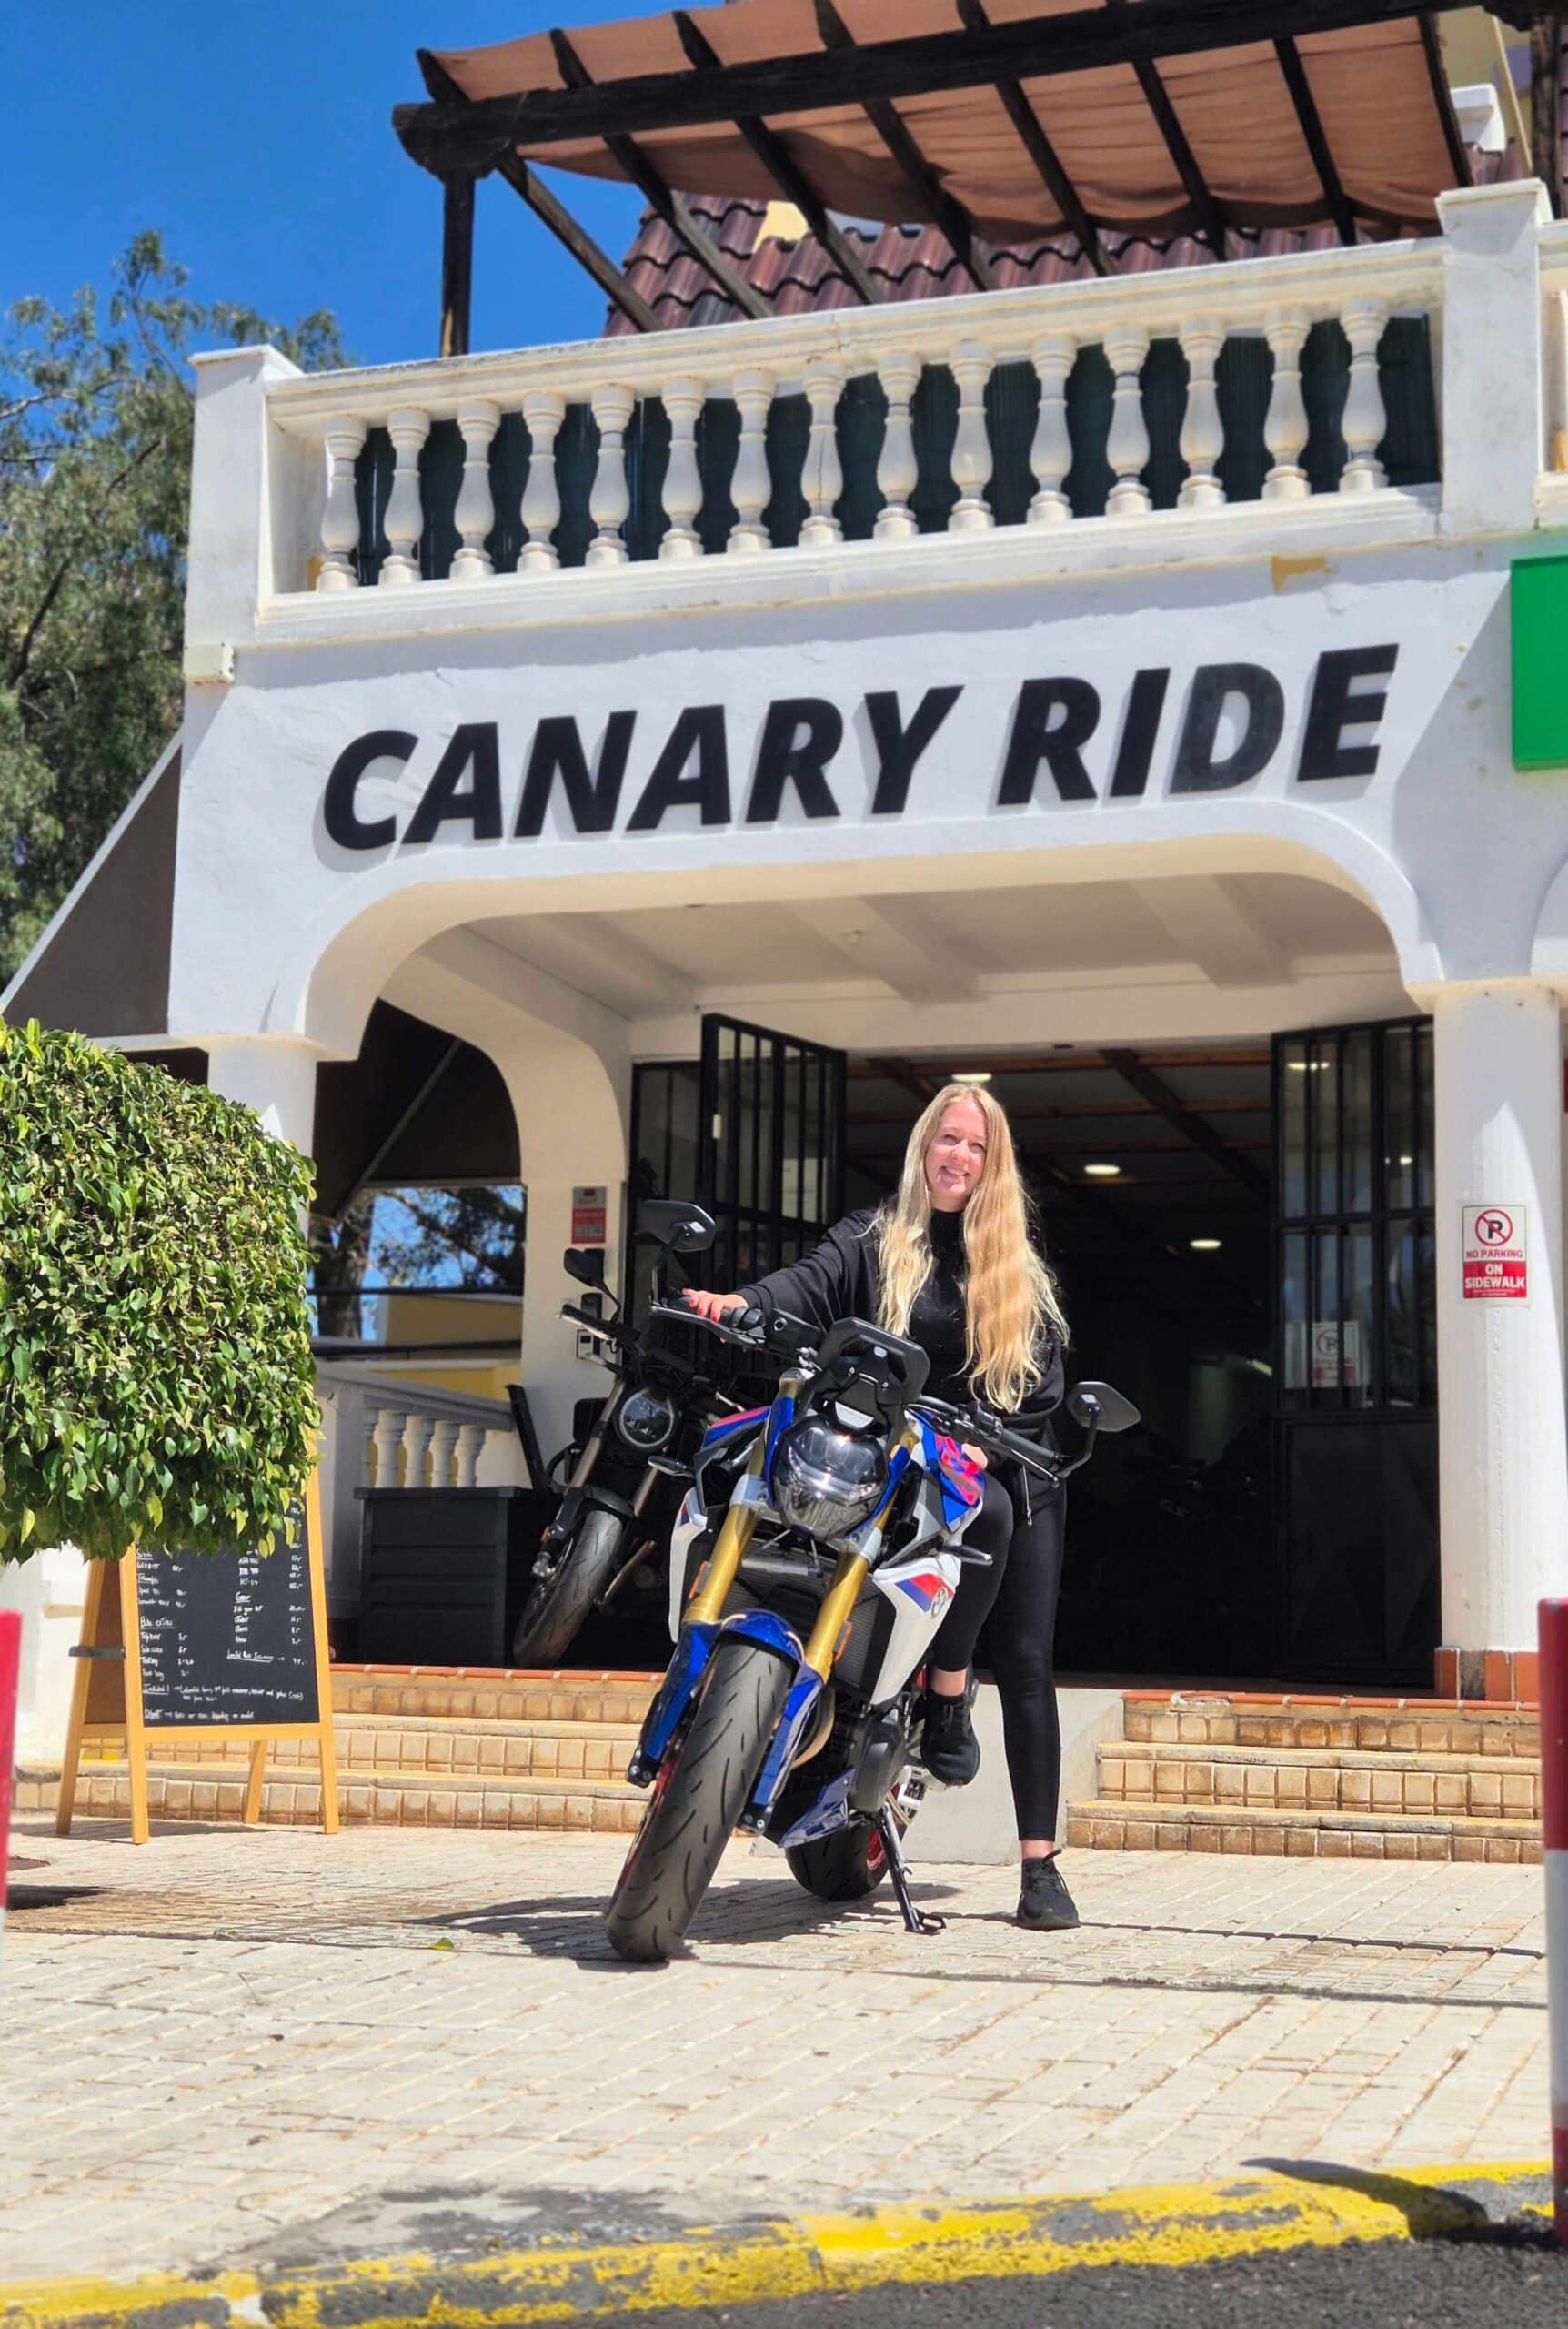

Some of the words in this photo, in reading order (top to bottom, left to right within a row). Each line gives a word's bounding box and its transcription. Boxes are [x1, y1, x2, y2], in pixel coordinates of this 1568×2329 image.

[325, 685, 963, 850] CANARY
[997, 643, 1399, 806] RIDE
[1465, 1251, 1479, 1259] NO
[1481, 1249, 1523, 1259] PARKING
[1485, 1264, 1503, 1275] ON
[1464, 1276, 1525, 1288] SIDEWALK
